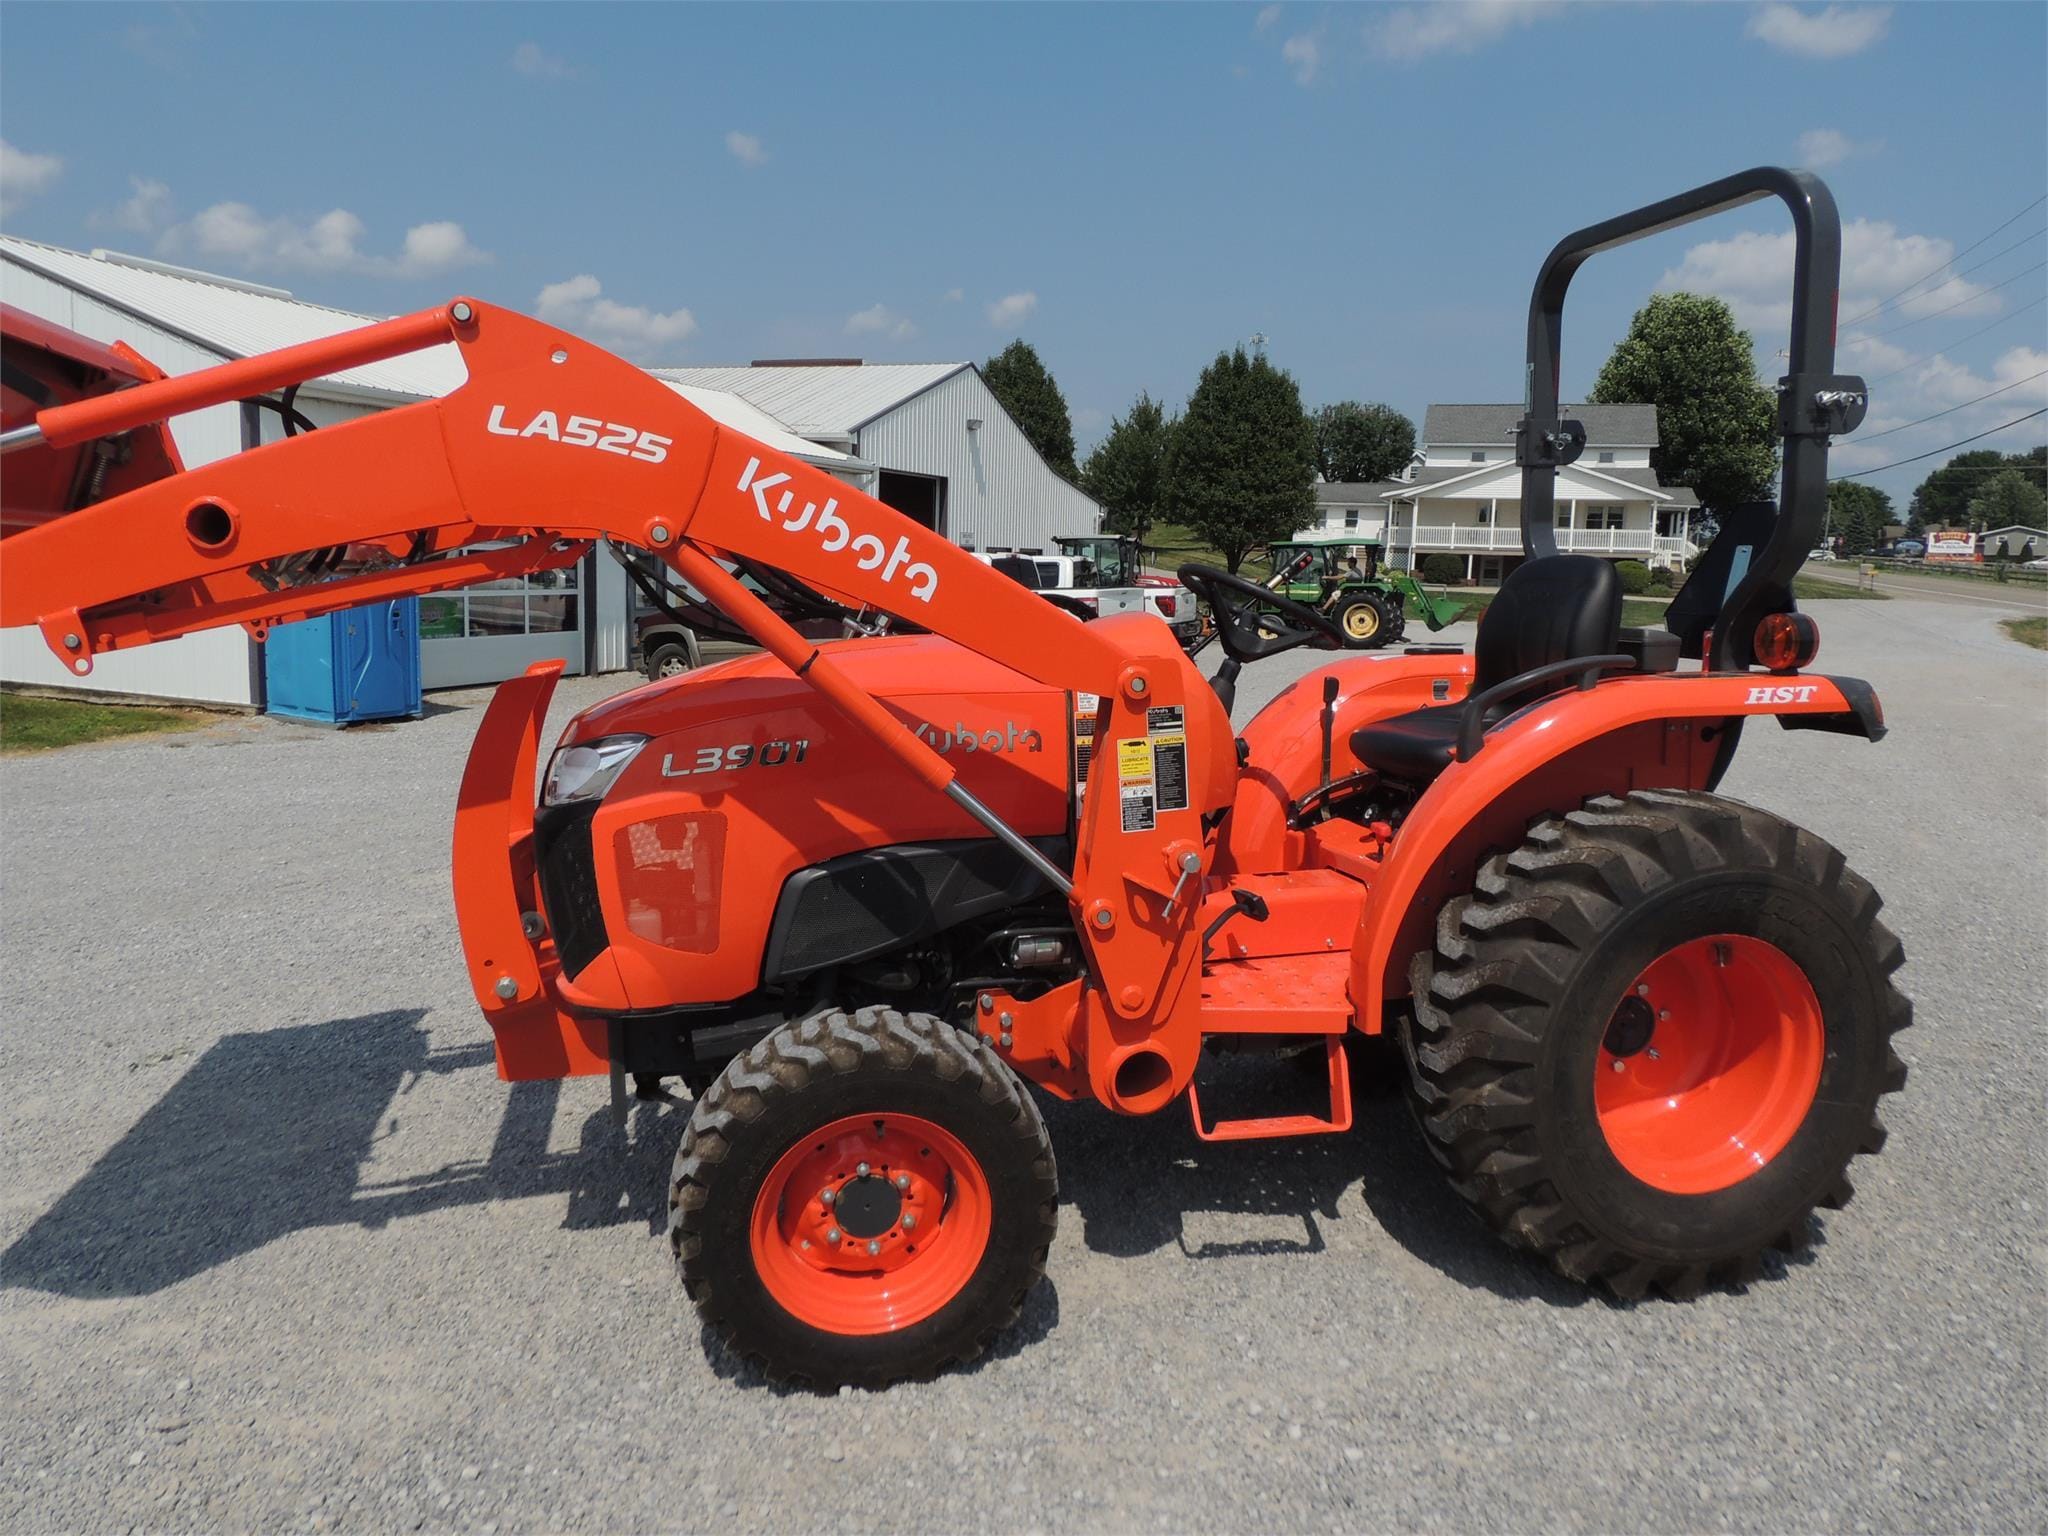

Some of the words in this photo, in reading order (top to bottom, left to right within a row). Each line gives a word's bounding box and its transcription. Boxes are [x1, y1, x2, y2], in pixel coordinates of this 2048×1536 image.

[487, 405, 673, 464] LA525
[736, 456, 938, 603] Kubota
[1744, 685, 1817, 705] HST
[661, 739, 809, 778] L3901
